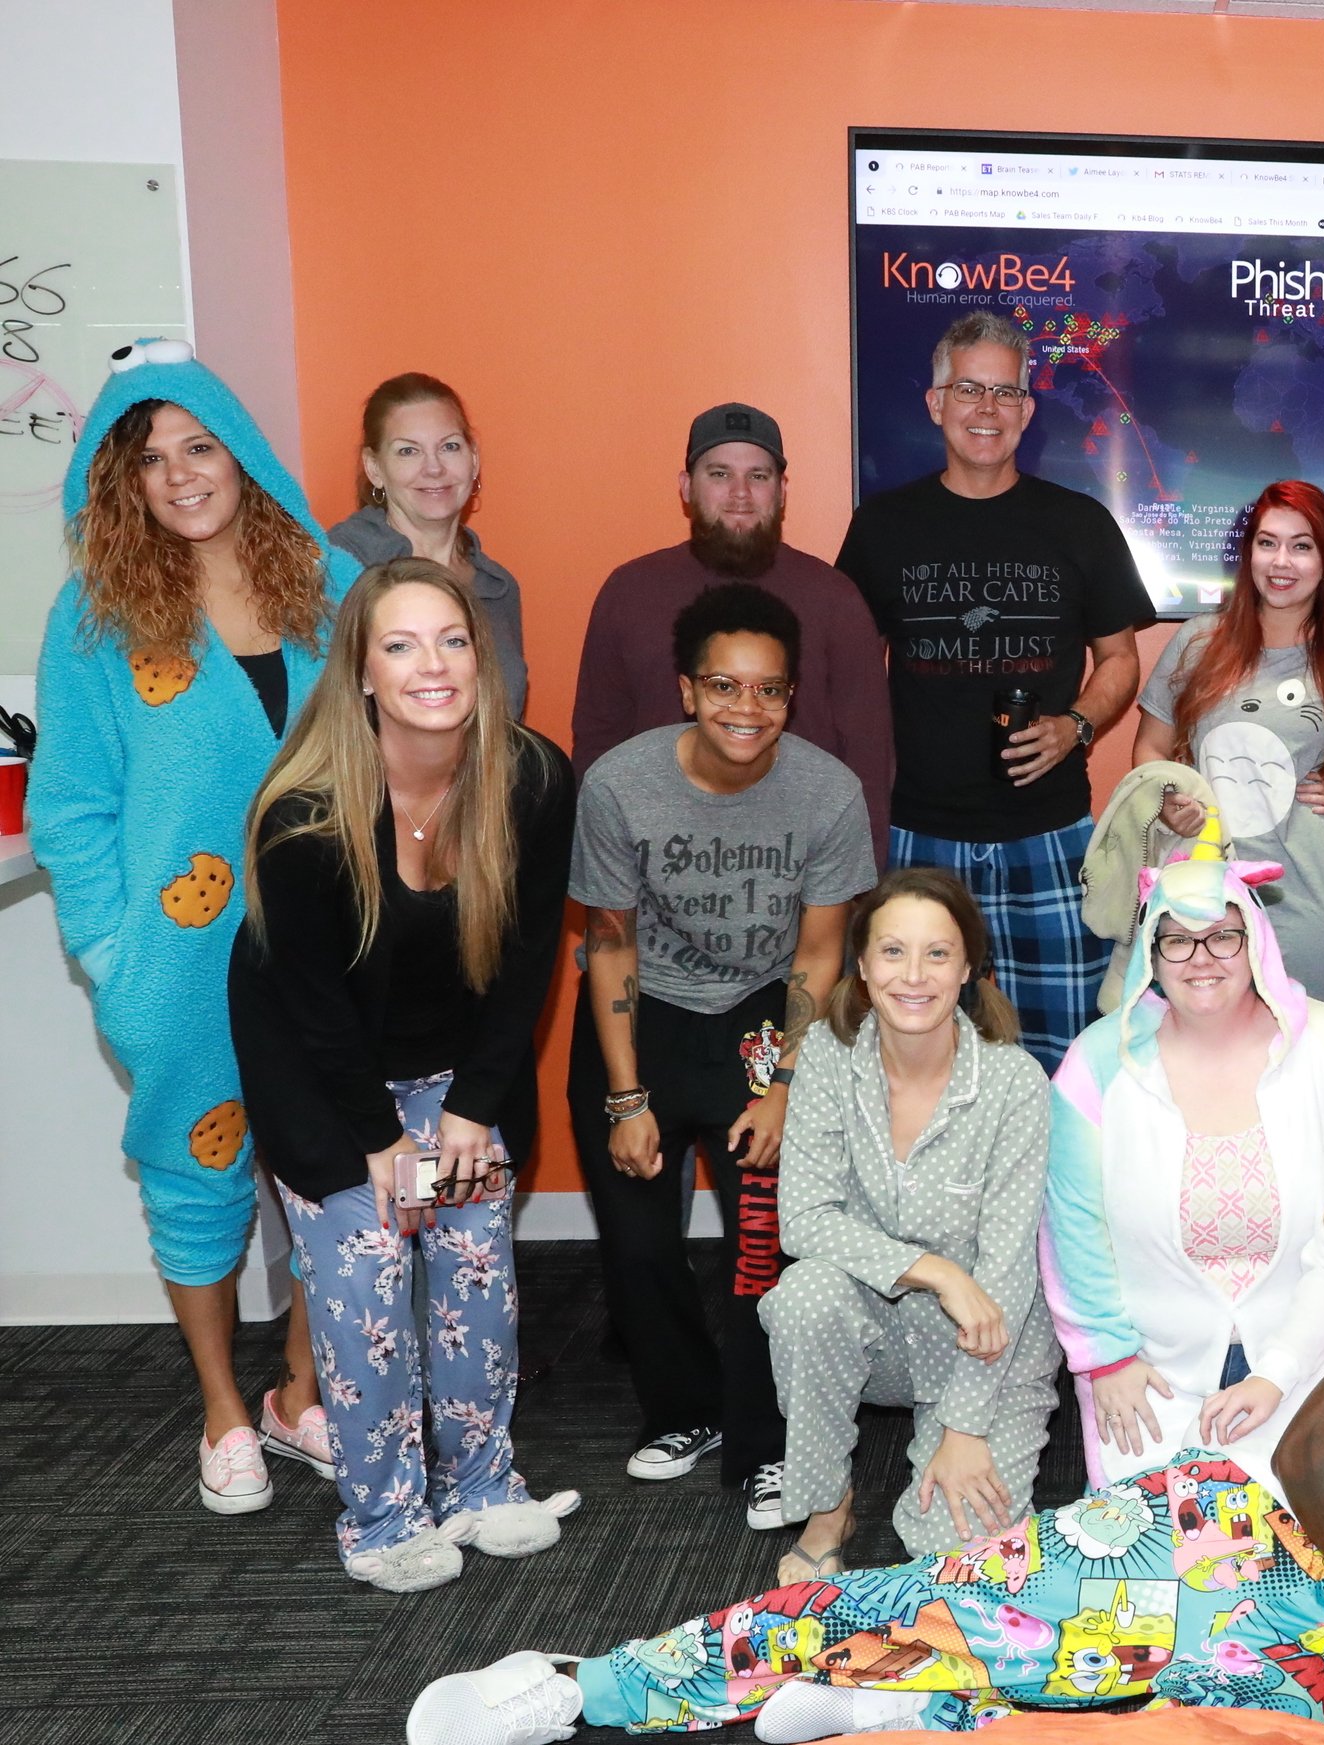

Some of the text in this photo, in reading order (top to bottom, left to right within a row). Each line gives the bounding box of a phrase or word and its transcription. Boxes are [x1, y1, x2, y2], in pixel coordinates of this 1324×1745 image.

[997, 166, 1015, 174] Brain
[961, 210, 988, 220] Reports
[990, 211, 1006, 221] Map
[1031, 211, 1050, 220] Sales
[1052, 212, 1072, 220] Team
[1074, 213, 1093, 222] Daily
[1248, 218, 1267, 226] Sales
[883, 252, 1076, 292] KnowBe4
[907, 291, 1076, 312] Human error. Conquered.
[1244, 300, 1315, 319] Threat
[1042, 345, 1090, 354] United States
[1191, 504, 1239, 515] Virginia,
[1189, 541, 1236, 552] Virginia,
[1191, 553, 1218, 562] Minas
[902, 562, 1060, 582] NOT ALL HEROES
[902, 581, 1060, 605] WEAR CAPES
[906, 636, 1055, 660] SOME JUST
[957, 659, 994, 675] THE
[661, 831, 806, 884] Solemnly
[657, 890, 733, 920] wear
[703, 928, 732, 955] to
